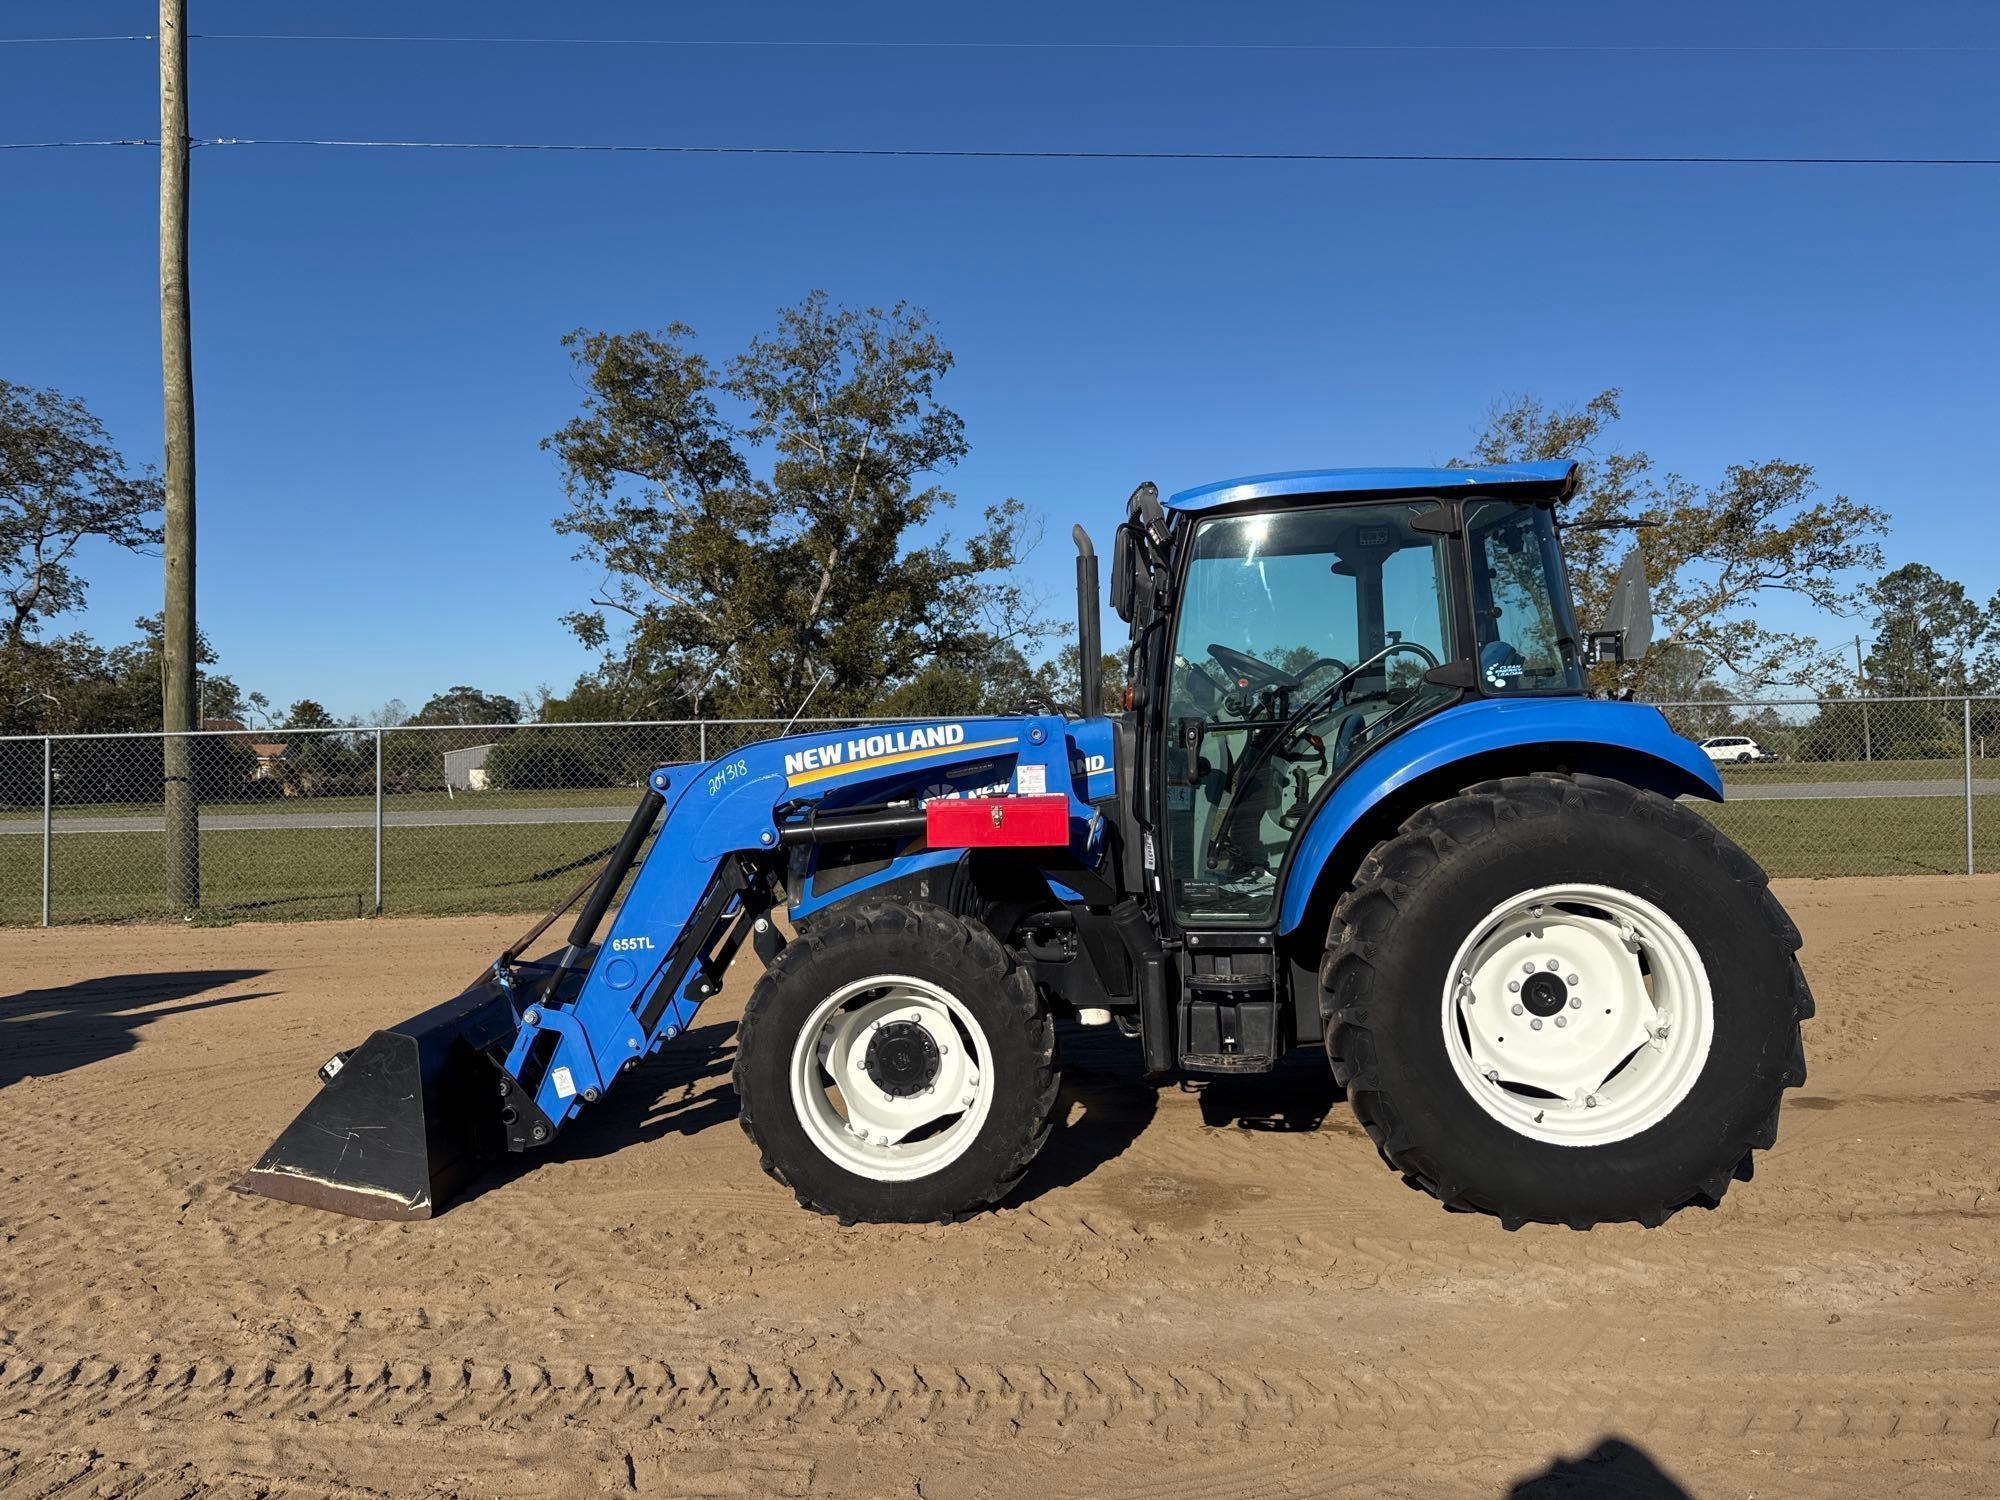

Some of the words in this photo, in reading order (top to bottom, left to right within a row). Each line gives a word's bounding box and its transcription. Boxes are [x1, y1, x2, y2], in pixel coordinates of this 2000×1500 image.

[785, 743, 842, 774] NEW
[847, 724, 965, 761] HOLLAND
[708, 759, 748, 797] 204318
[612, 936, 655, 951] 655TL
